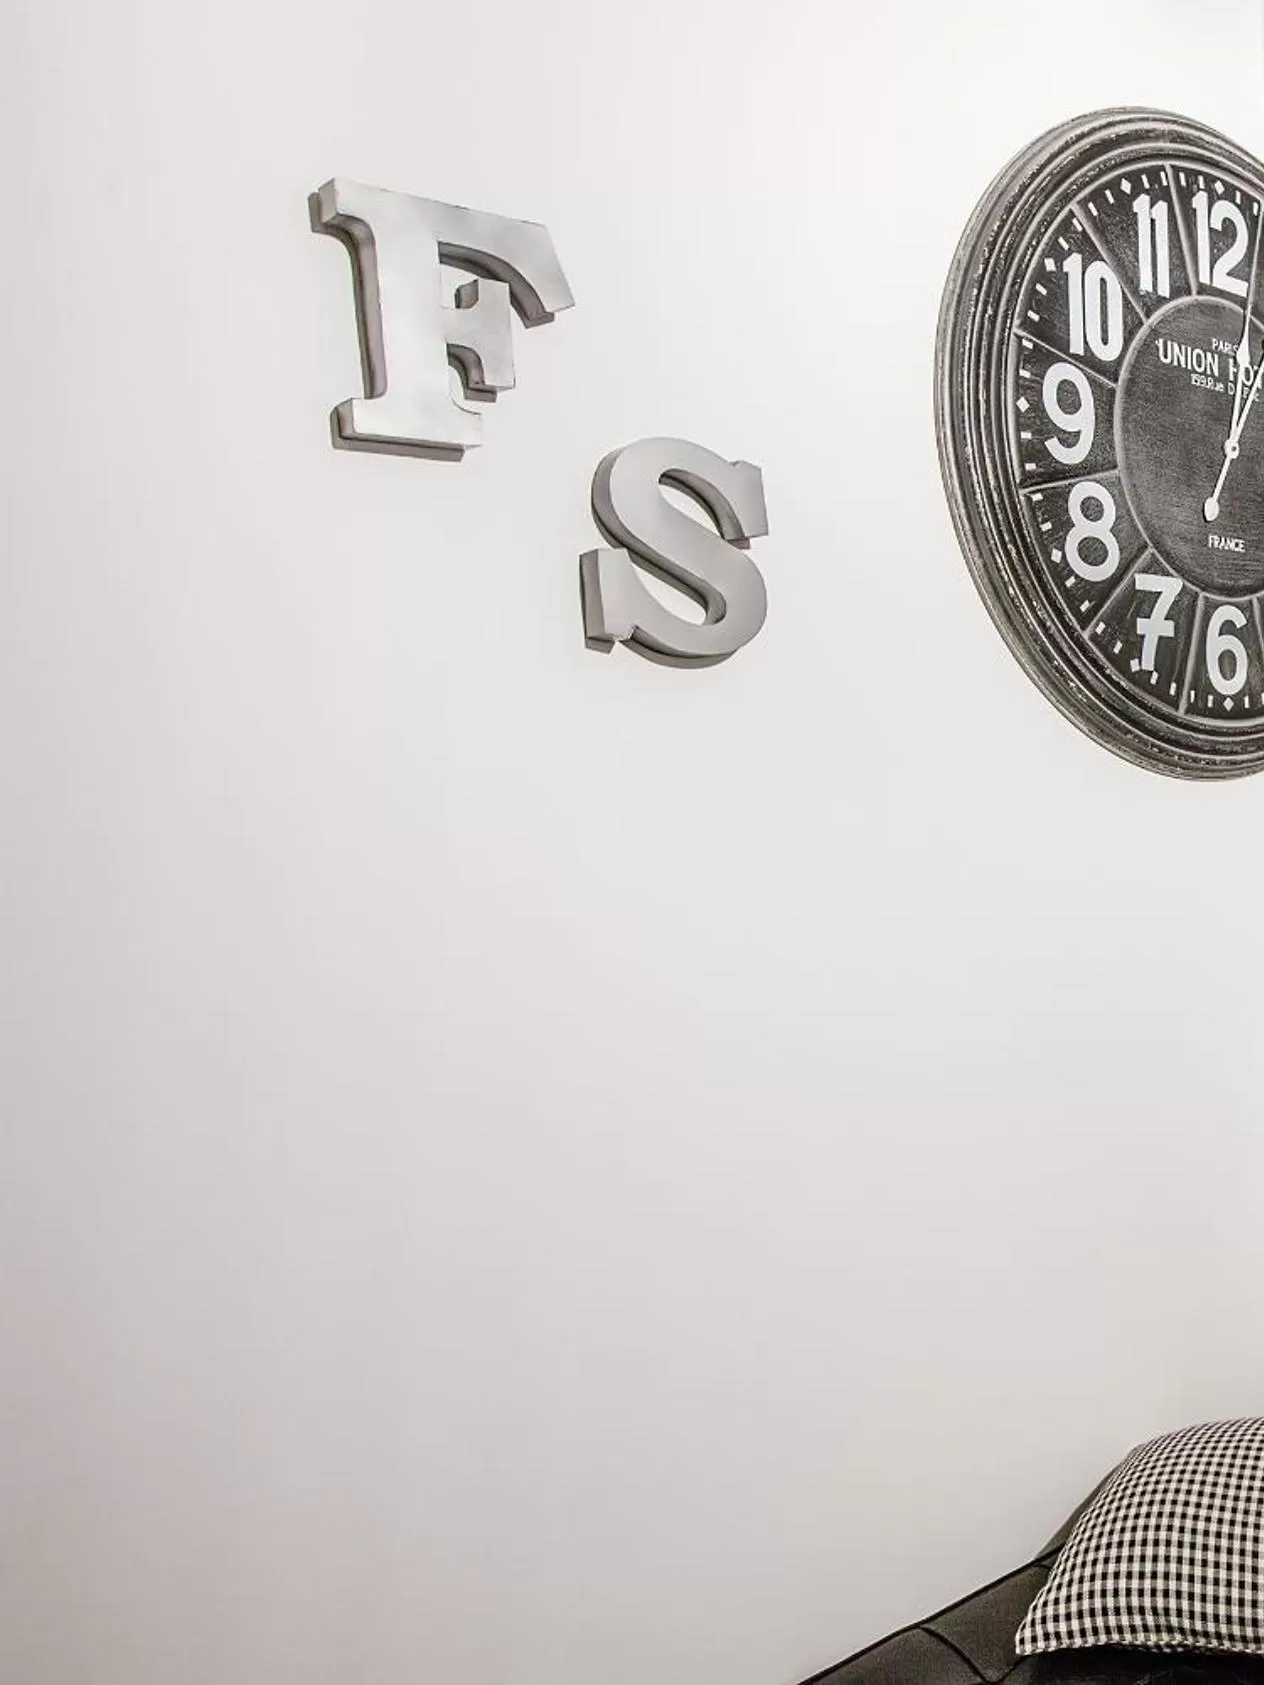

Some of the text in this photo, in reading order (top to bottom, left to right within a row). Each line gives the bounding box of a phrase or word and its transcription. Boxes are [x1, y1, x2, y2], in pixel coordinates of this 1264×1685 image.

[1132, 193, 1170, 299] 11
[1192, 190, 1250, 298] 12
[308, 178, 575, 462] F
[1062, 252, 1122, 362] 10
[1156, 338, 1219, 377] UNION
[1042, 362, 1096, 464] 9
[578, 436, 769, 671] S
[1064, 481, 1120, 582] 8
[1208, 534, 1246, 552] FRANCE
[1135, 574, 1183, 671] 7
[1206, 606, 1248, 695] 6
